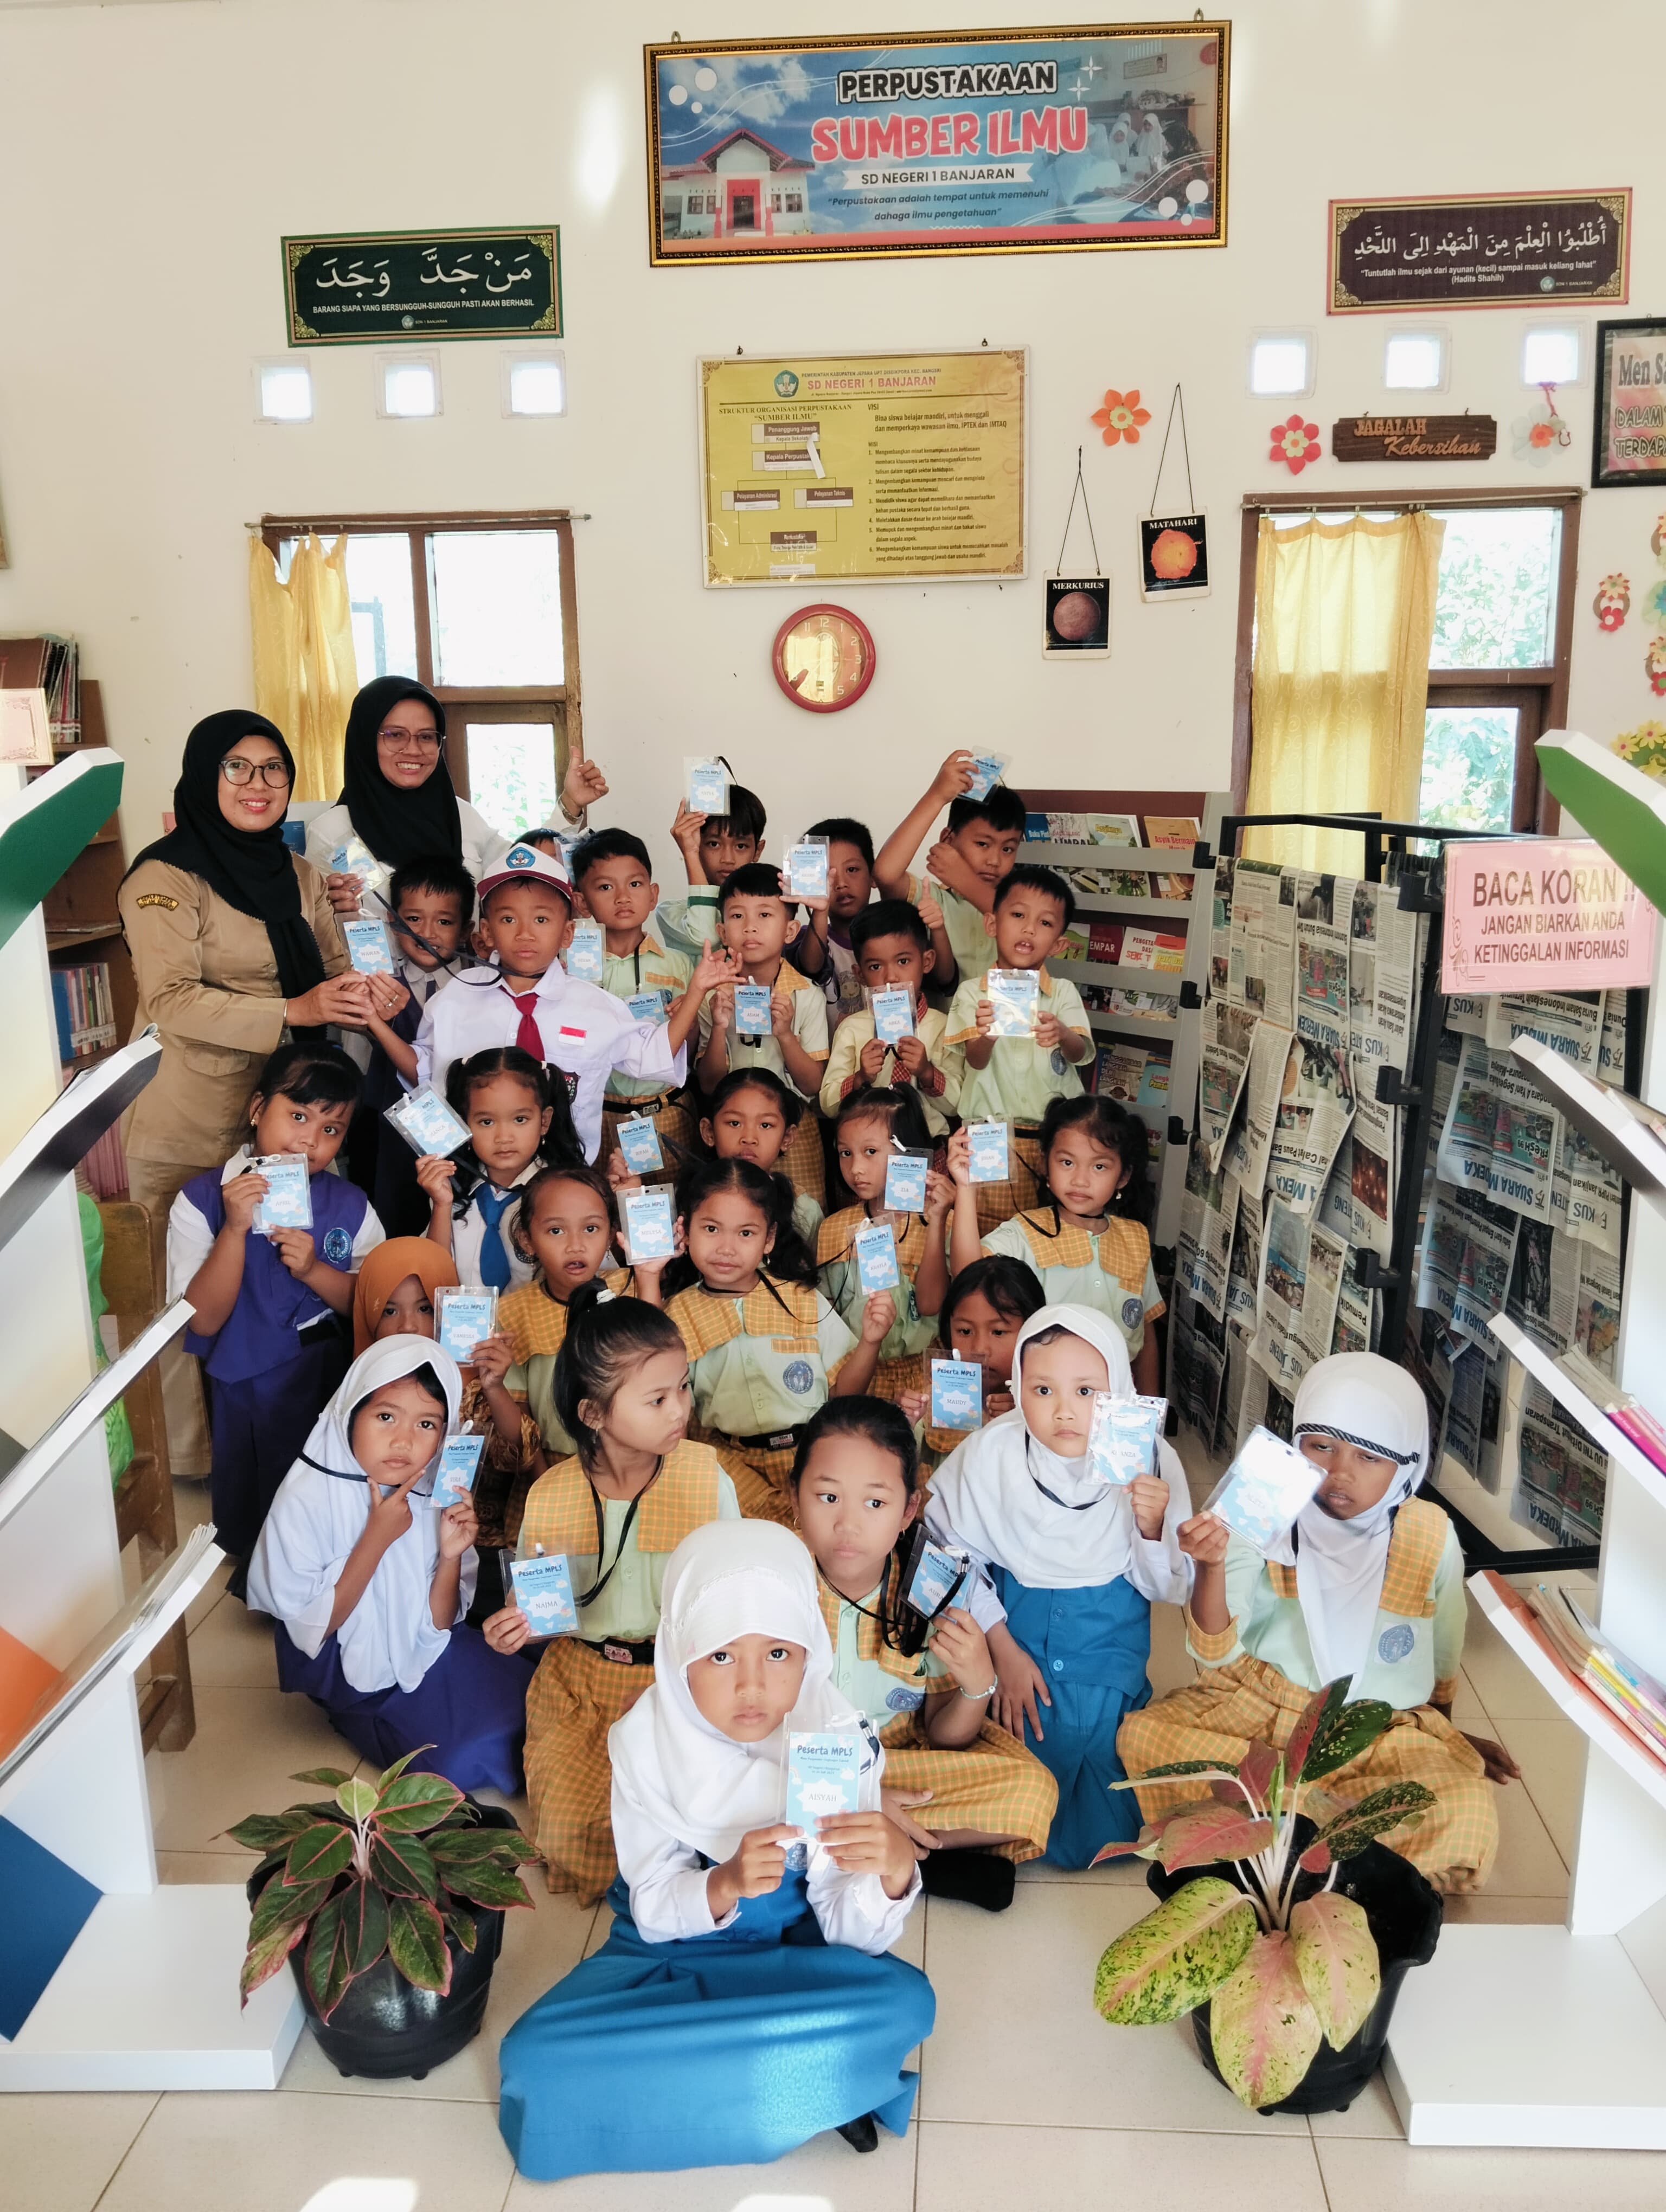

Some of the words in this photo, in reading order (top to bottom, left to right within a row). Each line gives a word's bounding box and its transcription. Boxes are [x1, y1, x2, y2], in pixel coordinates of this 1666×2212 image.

[842, 65, 1055, 100] PERPUSTAKAAN
[812, 113, 981, 161] SUMBER
[988, 106, 1087, 156] ILMU
[861, 173, 879, 184] SD
[882, 171, 928, 183] NEGERI
[932, 170, 937, 182] 1
[940, 168, 1015, 182] BANJARAN
[898, 194, 931, 204] adalah
[933, 192, 967, 203] tempat
[970, 191, 996, 201] untuk
[998, 189, 1049, 200] memenuhi
[874, 212, 910, 222] dahaga
[912, 210, 933, 219] ilmu
[1398, 267, 1413, 275] ilmu
[1414, 267, 1433, 276] sejak
[1449, 266, 1475, 275] ayunan
[1476, 264, 1497, 274] (kecil)
[1498, 263, 1523, 274] sampai
[1524, 262, 1547, 271] masuk
[1549, 261, 1575, 272] keliang
[1452, 275, 1476, 285] (Hadits
[1477, 273, 1504, 284] Shahih)
[312, 305, 341, 313] BARANG
[381, 301, 460, 311] BERSUNGGUH-SUNGGUH
[462, 300, 480, 308] PASTI
[501, 299, 534, 307] BERHASIL
[1618, 354, 1650, 387] Men
[1655, 352, 1666, 385] S
[808, 381, 821, 390] SD
[825, 378, 864, 390] NEGERI
[869, 378, 873, 388] 1
[877, 376, 936, 388] BANJARAN
[799, 404, 852, 412] PERPUSTAKAAN
[1615, 406, 1663, 429] DALAM
[1354, 417, 1427, 437] JAGALAH
[1384, 435, 1481, 458] Kebersihan
[1149, 518, 1198, 530] MATAHARI
[1052, 582, 1105, 590] MERKURIUS
[1155, 835, 1171, 845] Asyik
[1171, 835, 1196, 845] Bermain
[1473, 870, 1534, 907] BACA
[1541, 867, 1617, 905] KORAN
[1481, 914, 1532, 935] JANGAN
[1535, 912, 1590, 934] BIARKAN
[1592, 910, 1625, 931] ANDA
[1089, 941, 1116, 953] EMPAR
[1474, 942, 1562, 964] KETINGGALAN
[1565, 939, 1629, 961] INFORMASI
[638, 1123, 651, 1132] MPLS
[1500, 1178, 1534, 1206] SUARA
[861, 1237, 877, 1245] Peserta
[877, 1232, 889, 1241] MPLS
[448, 1303, 470, 1311] Peserta
[937, 1367, 959, 1375] Peserta
[960, 1369, 977, 1378] MPLS
[928, 1552, 949, 1572] Peserta
[518, 1567, 543, 1578] Peserta
[544, 1564, 562, 1573] MPLS
[535, 1600, 558, 1609] NAJMA
[797, 1745, 829, 1756] Peserta
[831, 1746, 853, 1757] MPLS
[808, 1792, 837, 1802] AISYAH
